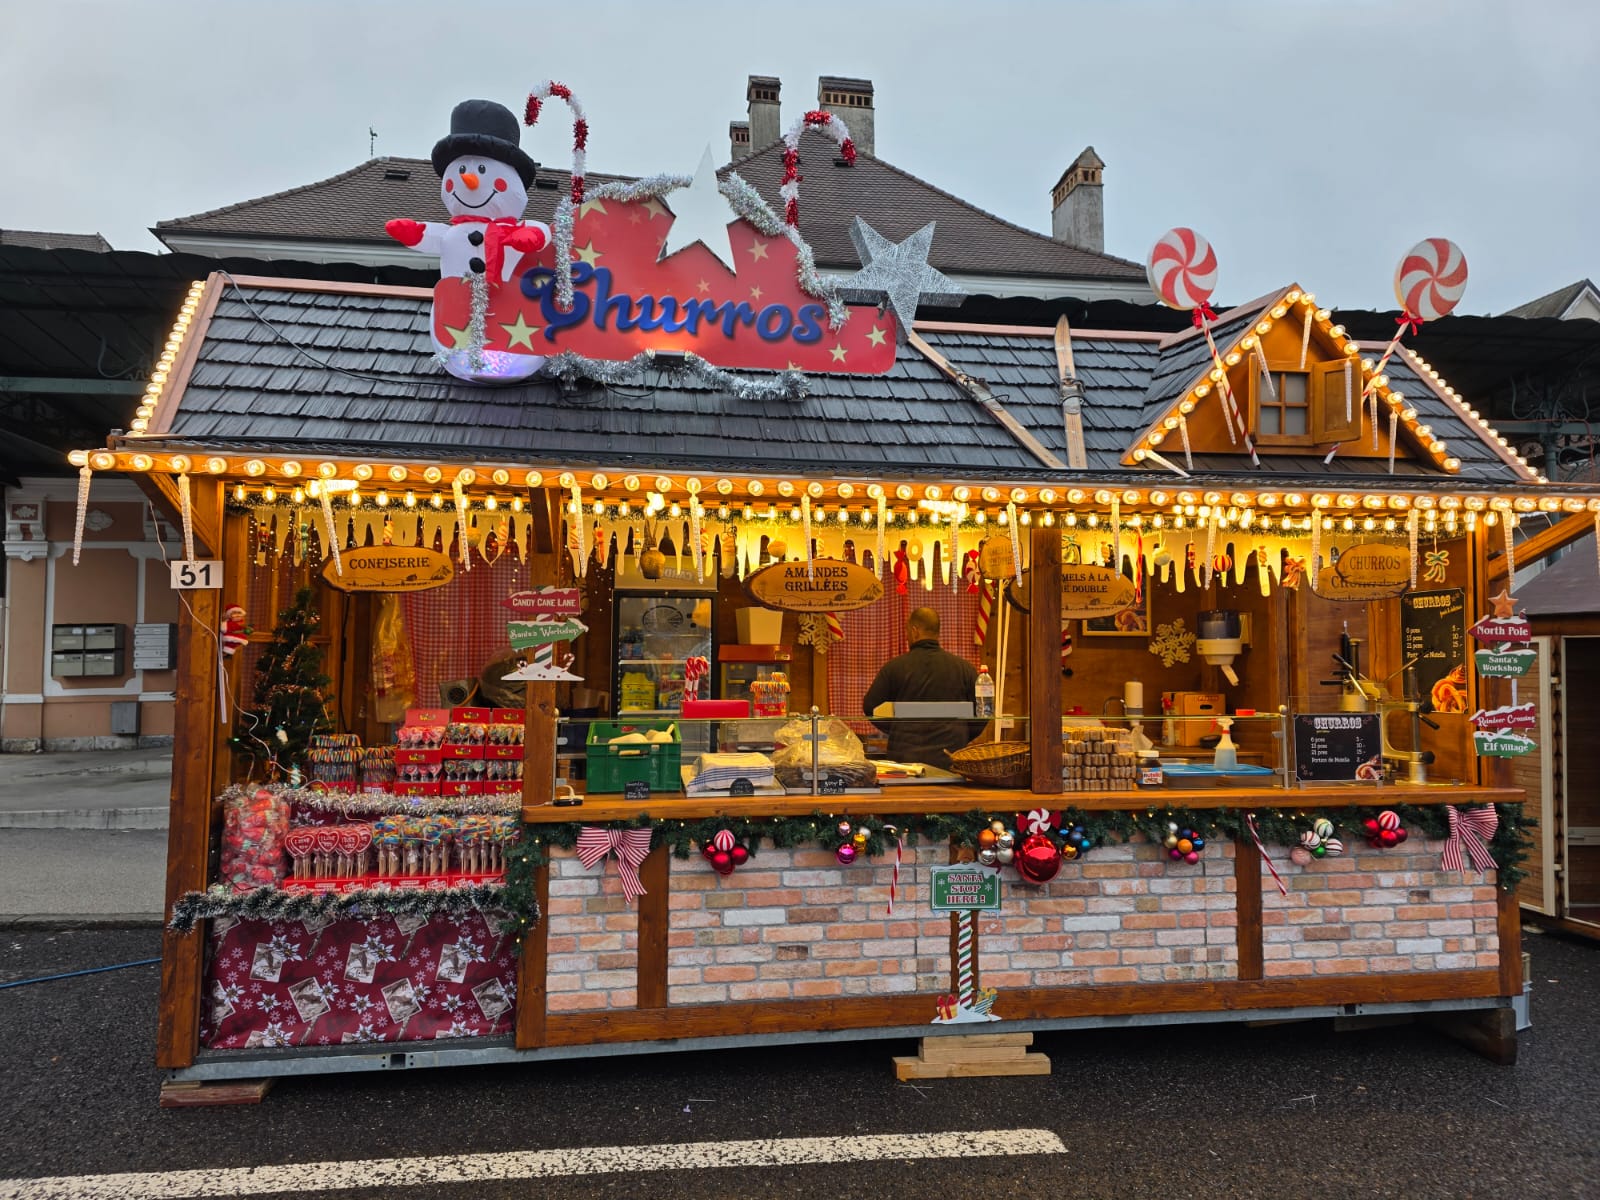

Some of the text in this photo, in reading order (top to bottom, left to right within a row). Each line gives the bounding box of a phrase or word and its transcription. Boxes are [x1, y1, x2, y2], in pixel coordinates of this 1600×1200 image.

[520, 262, 824, 343] Churros
[349, 557, 431, 570] CONFISERIE
[1349, 555, 1401, 570] CHURROS
[180, 564, 211, 586] 51
[1061, 573, 1086, 582] MELS
[1098, 573, 1110, 581] LA
[784, 579, 848, 592] GRILLÉES
[512, 598, 576, 607] CANDY CANE LANE
[1413, 594, 1451, 609] CHURROS
[1476, 626, 1528, 636] North Pole
[1482, 664, 1523, 673] Workshop
[1313, 717, 1362, 729] CHURROS
[1478, 714, 1536, 727] Reindeer Crossing
[1483, 742, 1528, 753] Elf Village
[948, 873, 984, 883] SANTA
[951, 884, 981, 894] STOP
[946, 895, 977, 904] HERE
